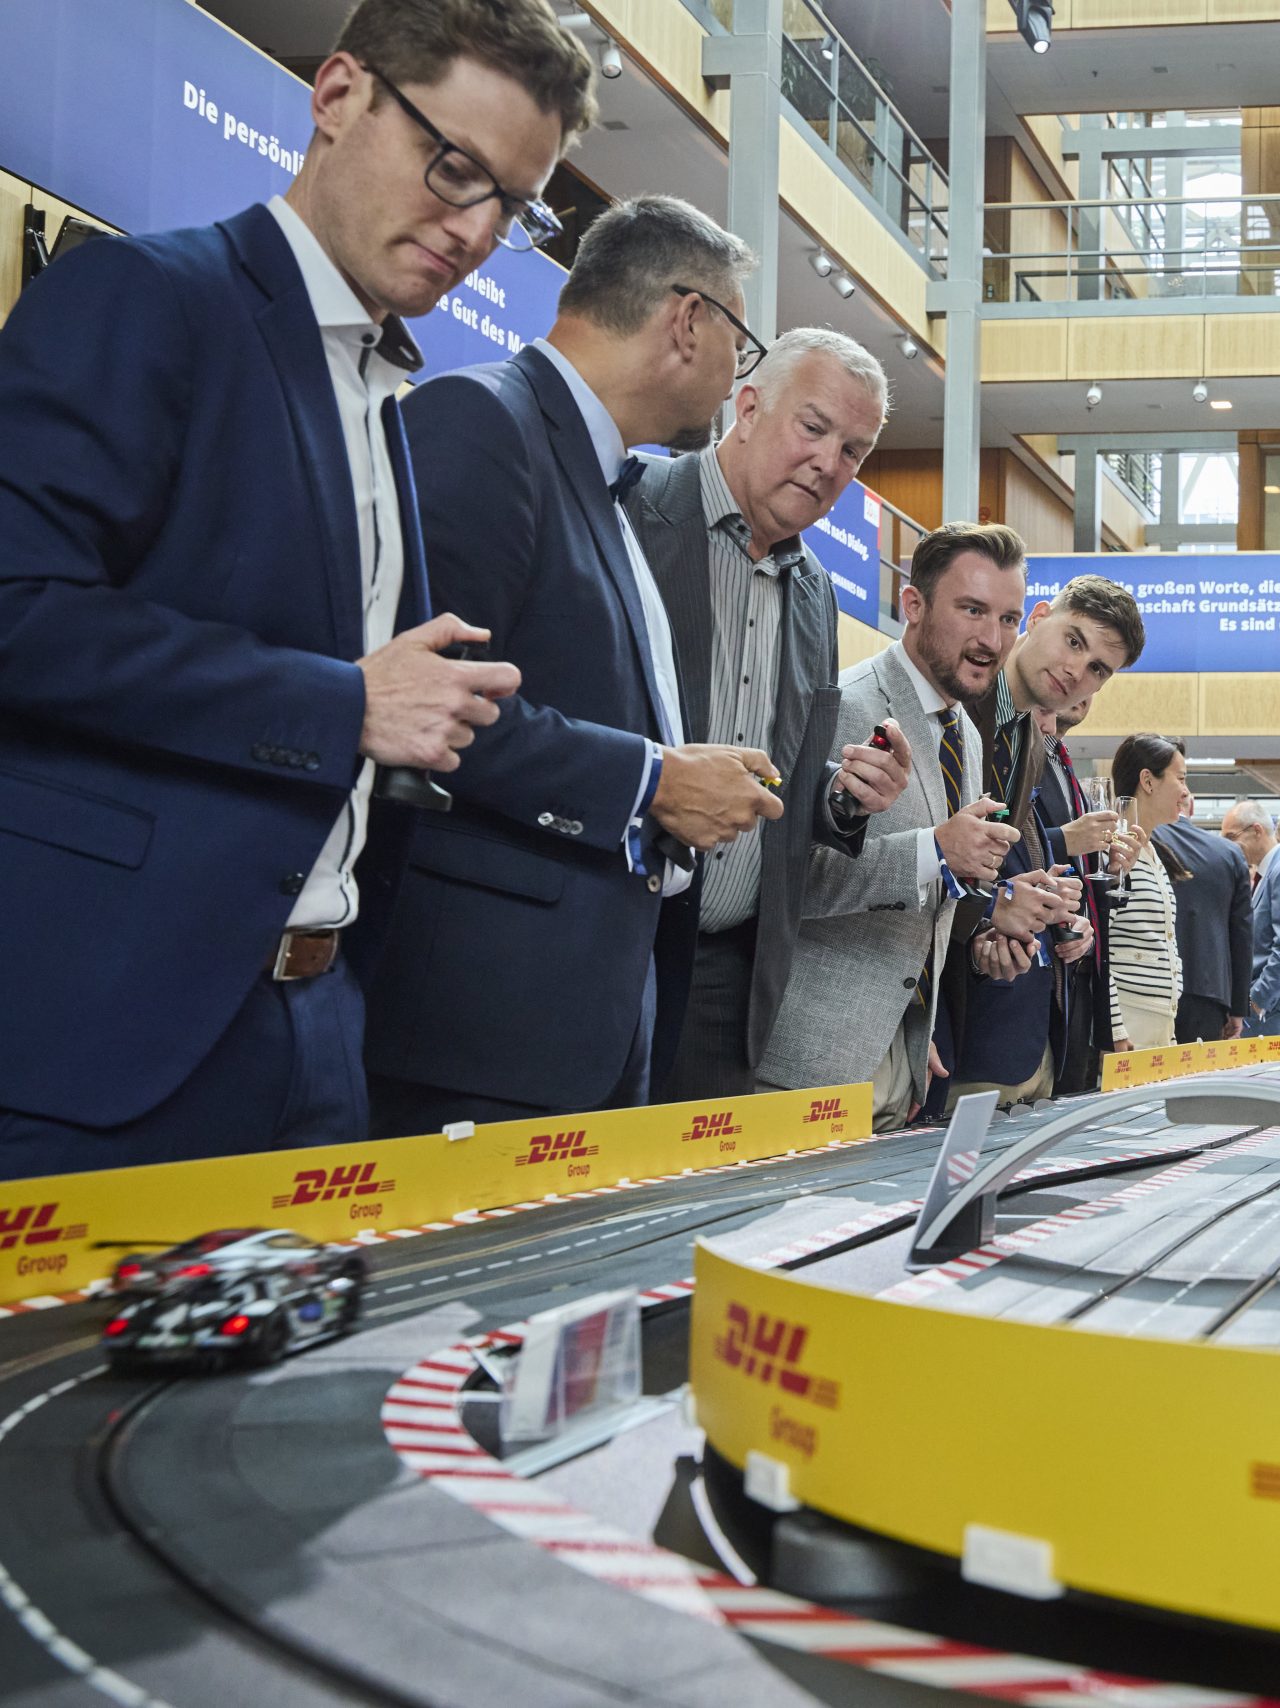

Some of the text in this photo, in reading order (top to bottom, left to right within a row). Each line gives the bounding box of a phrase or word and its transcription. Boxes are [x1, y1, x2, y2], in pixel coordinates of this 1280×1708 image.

[183, 81, 304, 176] Die persönli
[451, 297, 479, 330] Gut
[481, 315, 505, 346] des
[1026, 582, 1060, 597] sind
[1137, 580, 1196, 598] großen
[1199, 581, 1254, 596] Worte,
[1138, 600, 1196, 614] nschaft
[1219, 617, 1238, 631] Es
[1240, 617, 1276, 631] sind
[809, 1098, 842, 1122] DHL
[691, 1112, 735, 1140] DHL
[831, 1123, 844, 1134] Group
[527, 1130, 588, 1164] DHL
[719, 1140, 736, 1153] Group
[567, 1164, 590, 1178] Group
[290, 1162, 380, 1205] DHL
[350, 1203, 383, 1219] Group
[0, 1202, 63, 1250] HL
[16, 1254, 68, 1276] Group
[724, 1301, 813, 1397] DHL
